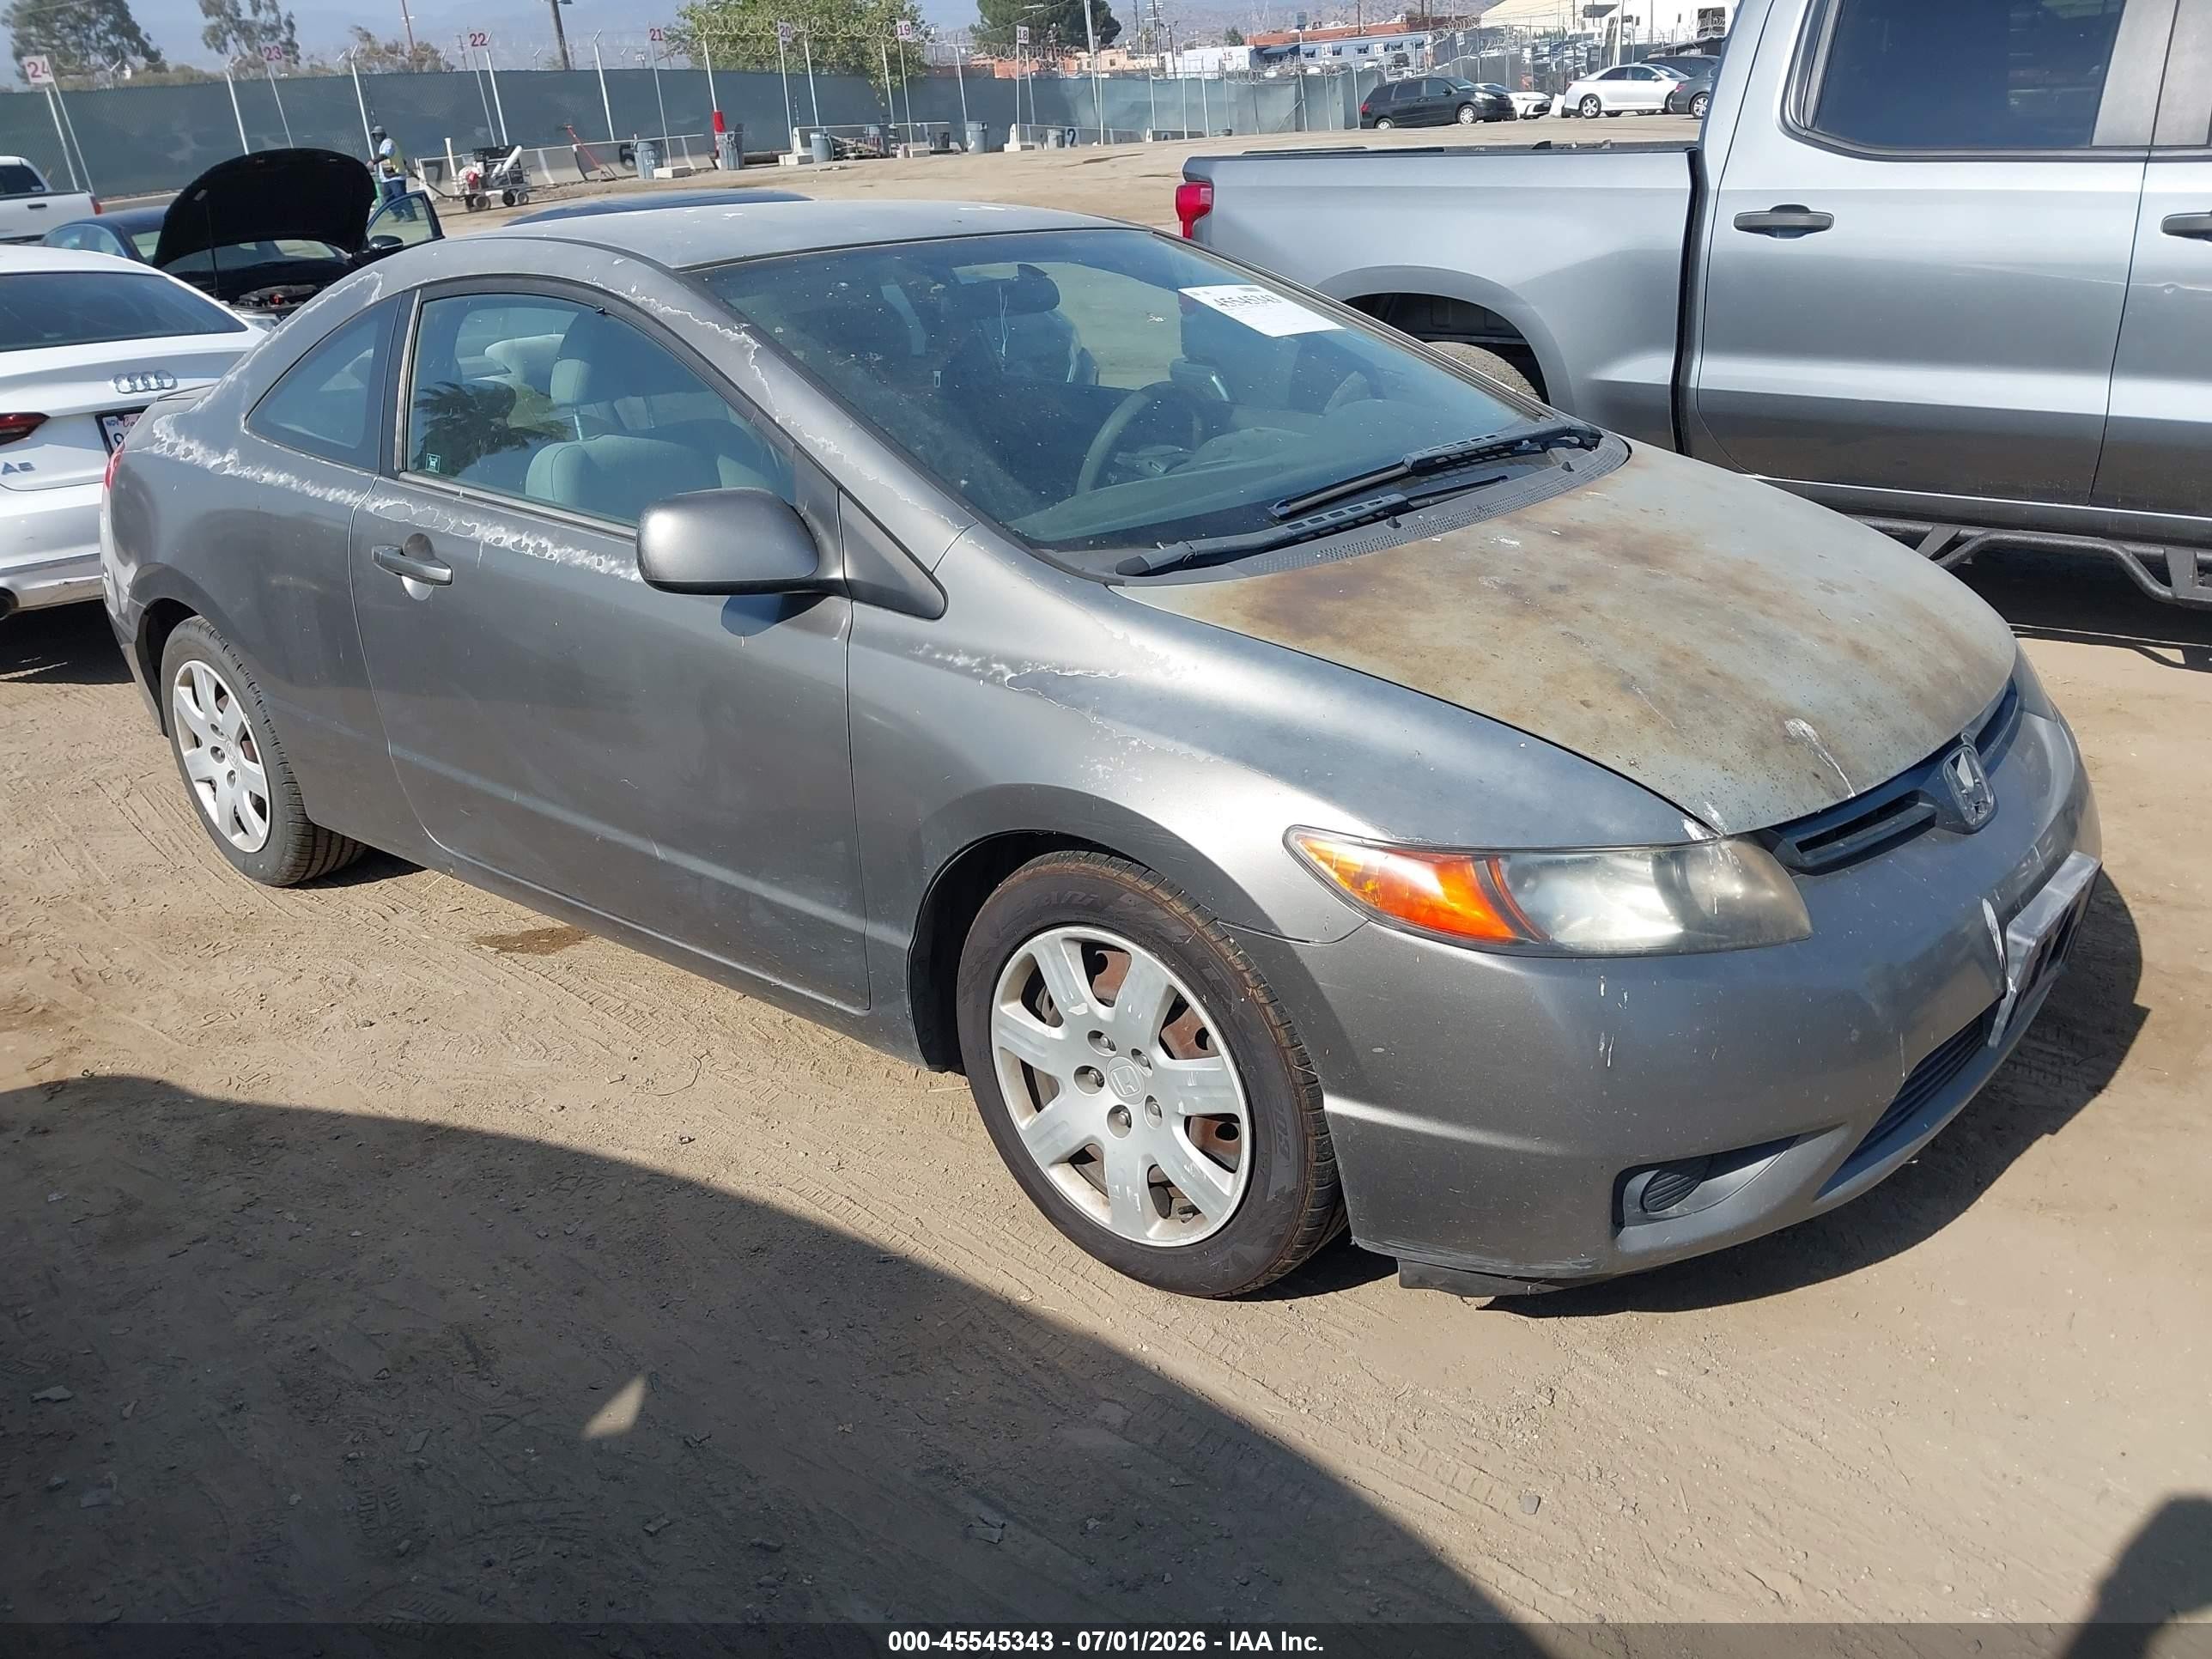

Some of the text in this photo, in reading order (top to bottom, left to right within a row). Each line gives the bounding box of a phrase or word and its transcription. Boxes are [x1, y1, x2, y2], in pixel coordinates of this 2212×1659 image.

[649, 28, 663, 41] 21
[780, 25, 791, 39] 20
[899, 24, 910, 35] 19
[1018, 29, 1028, 40] 18
[470, 33, 487, 47] 22
[264, 46, 282, 61] 23
[1223, 52, 1233, 61] 15
[27, 61, 52, 79] 24
